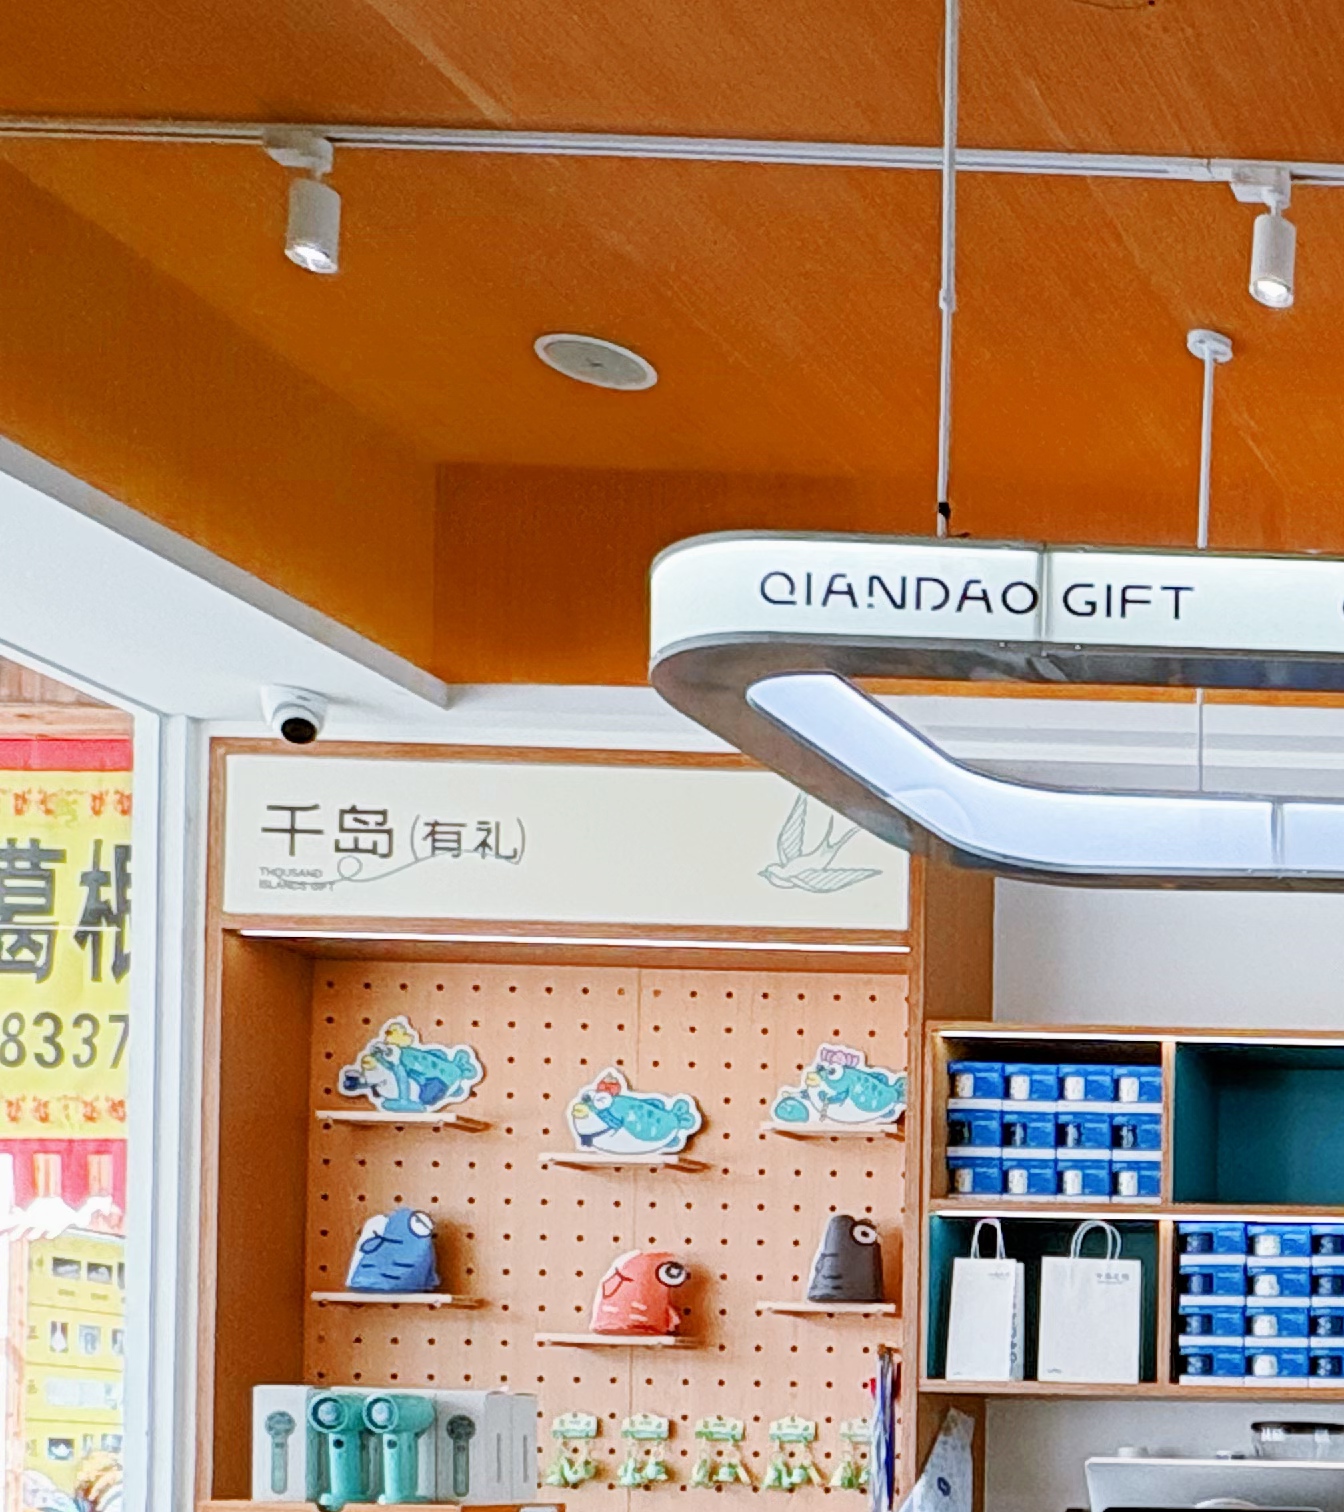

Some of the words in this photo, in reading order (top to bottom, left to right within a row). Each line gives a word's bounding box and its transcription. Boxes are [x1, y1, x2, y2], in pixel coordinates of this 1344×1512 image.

[759, 570, 1040, 615] QIANDAO
[1061, 582, 1195, 620] GIFT
[258, 866, 323, 879] THOUSAND
